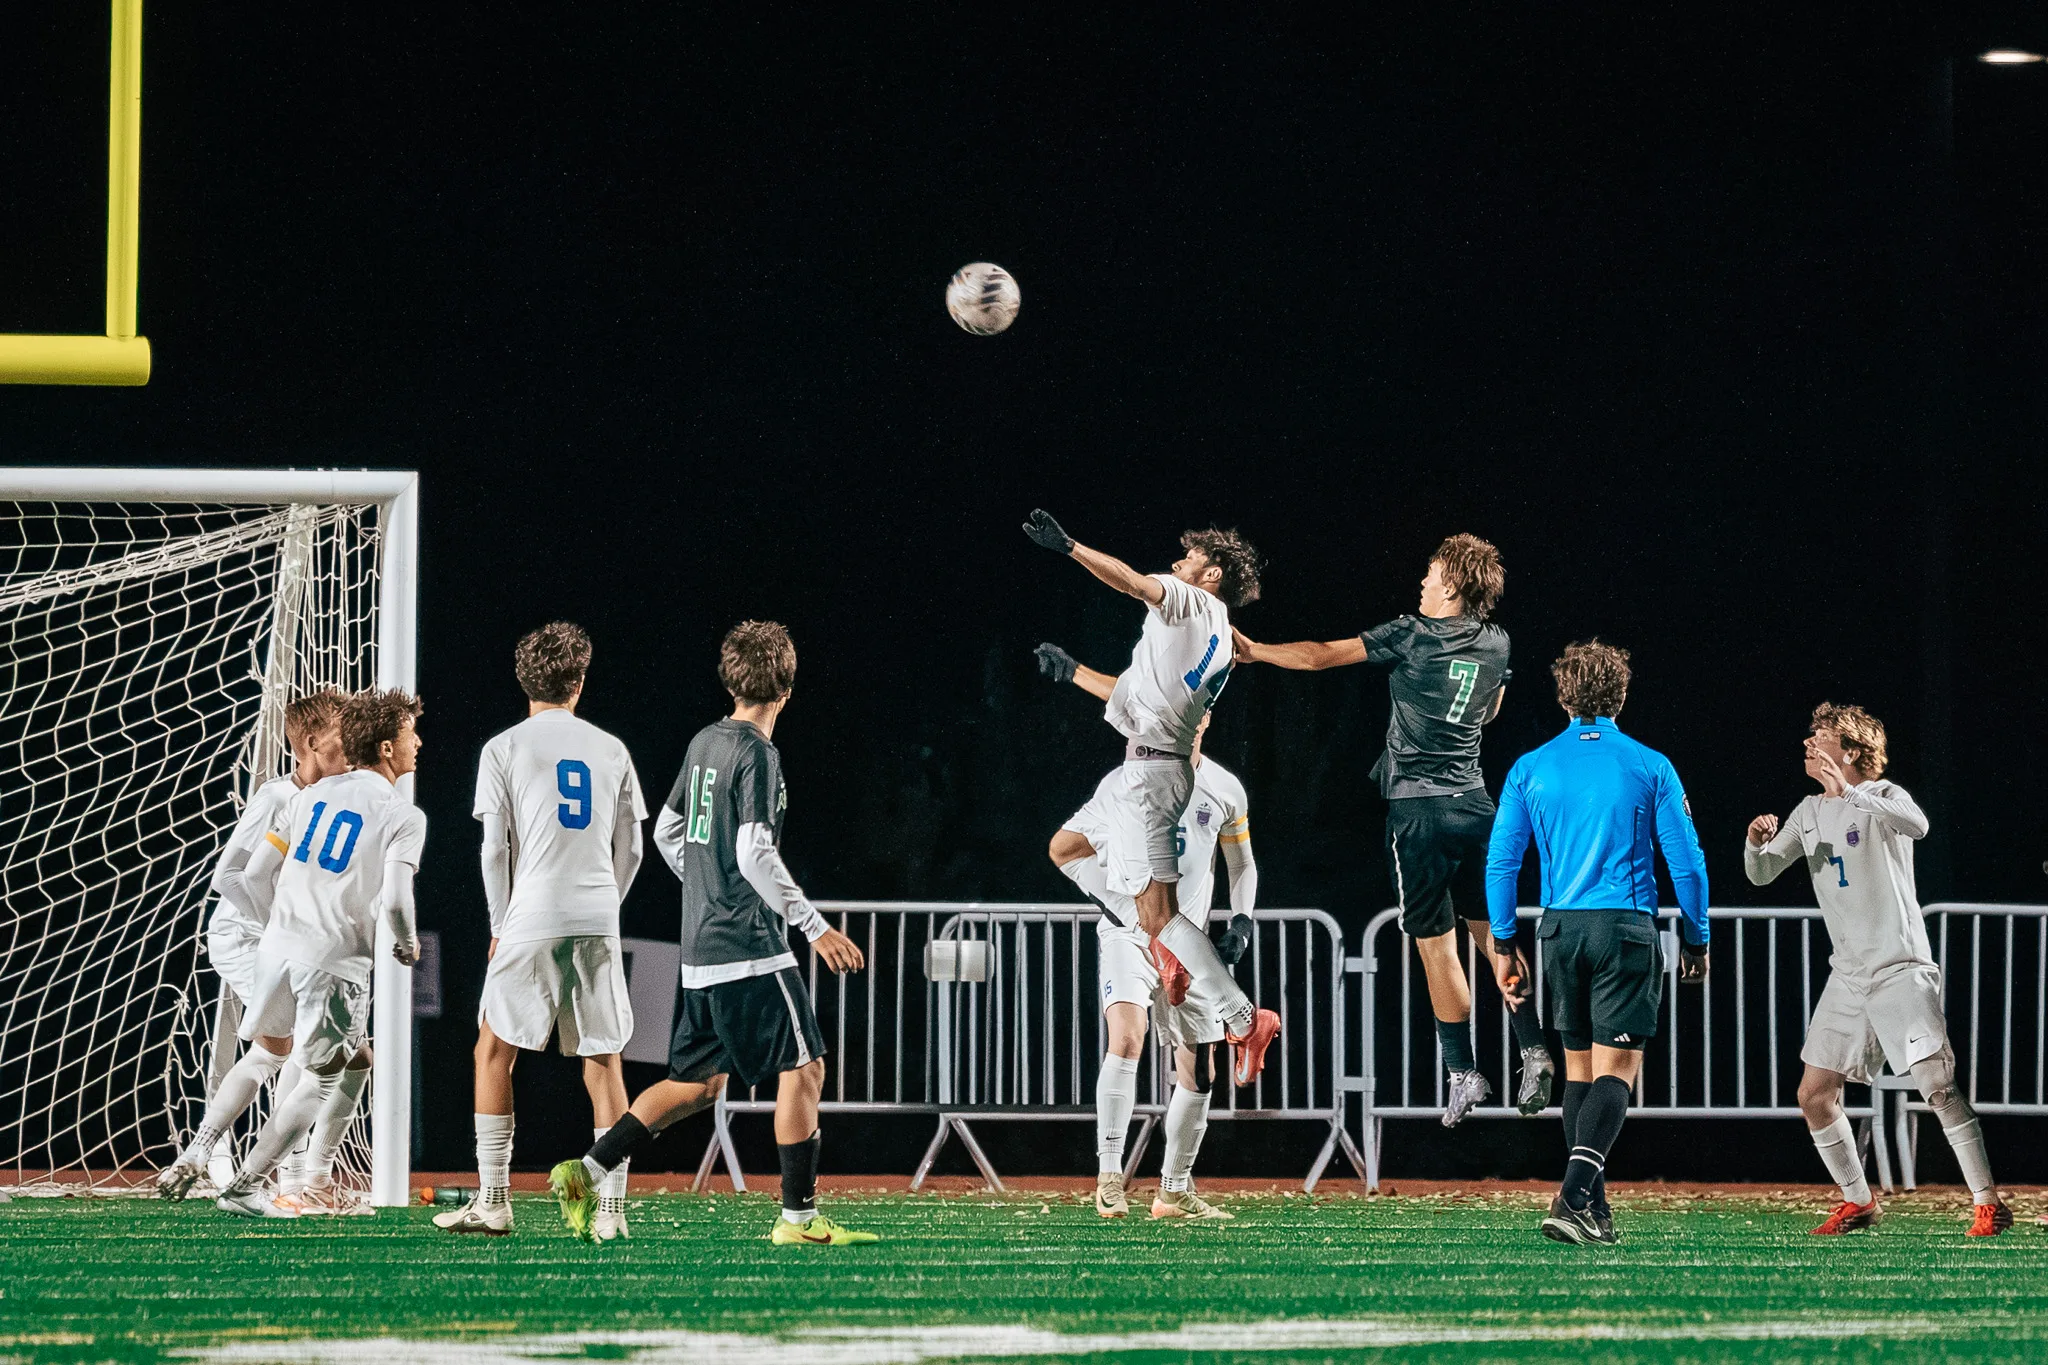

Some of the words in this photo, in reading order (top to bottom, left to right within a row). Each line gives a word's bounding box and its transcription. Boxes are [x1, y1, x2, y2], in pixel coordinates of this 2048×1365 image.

[1446, 659, 1480, 724] 7
[556, 758, 592, 830] 9
[686, 764, 718, 846] 15
[293, 800, 364, 874] 10
[1828, 855, 1850, 888] 7
